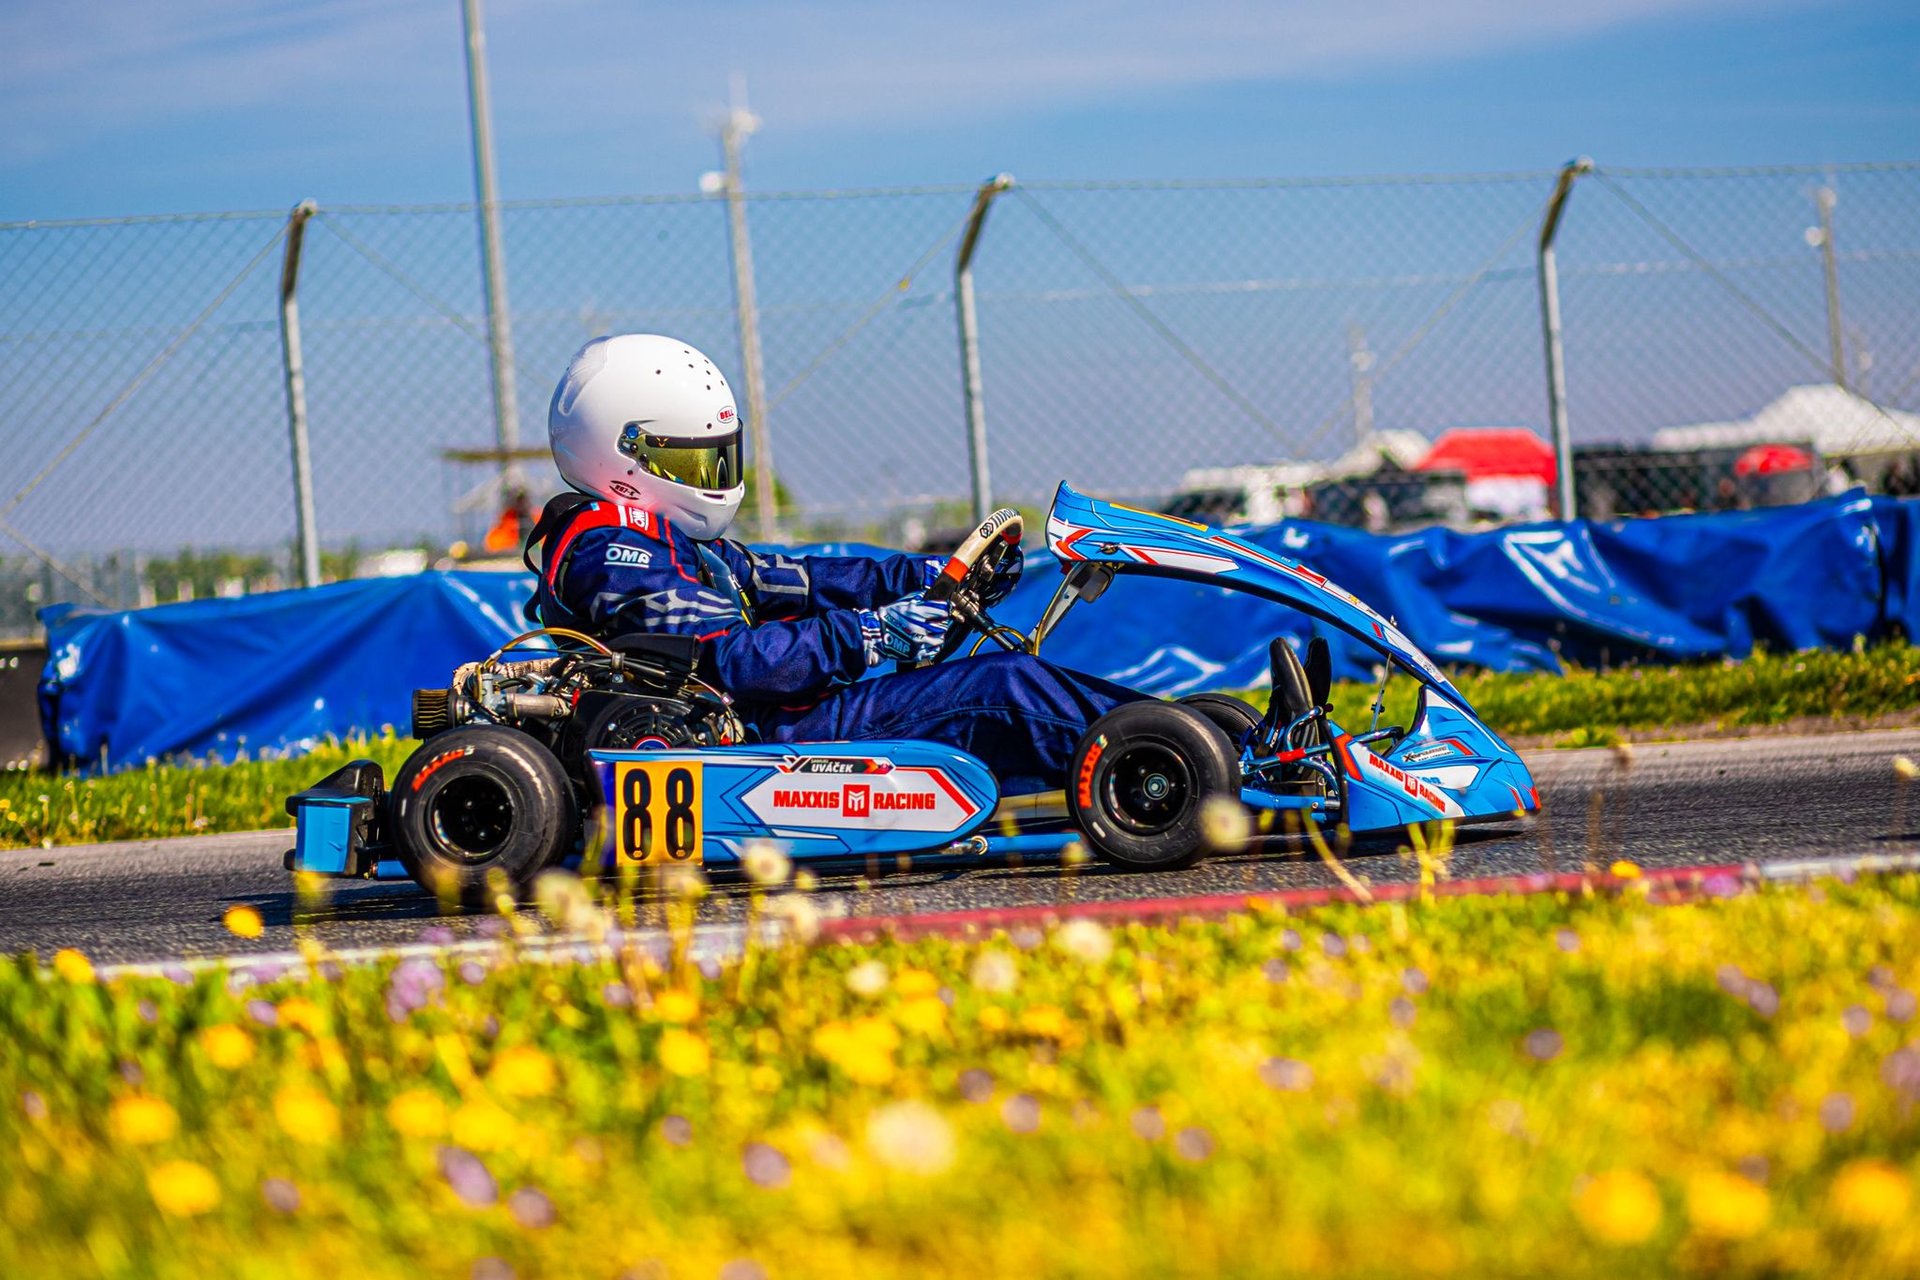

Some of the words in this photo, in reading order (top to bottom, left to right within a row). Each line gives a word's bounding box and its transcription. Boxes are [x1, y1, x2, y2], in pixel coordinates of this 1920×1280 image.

[719, 409, 735, 420] BELL
[883, 633, 911, 654] OMP
[810, 761, 854, 773] UVÁČEK
[1369, 753, 1404, 782] MAXXIS
[1419, 783, 1446, 814] RACING
[773, 790, 840, 808] MAXXIS
[873, 792, 936, 810] RACING
[622, 767, 696, 861] 88
